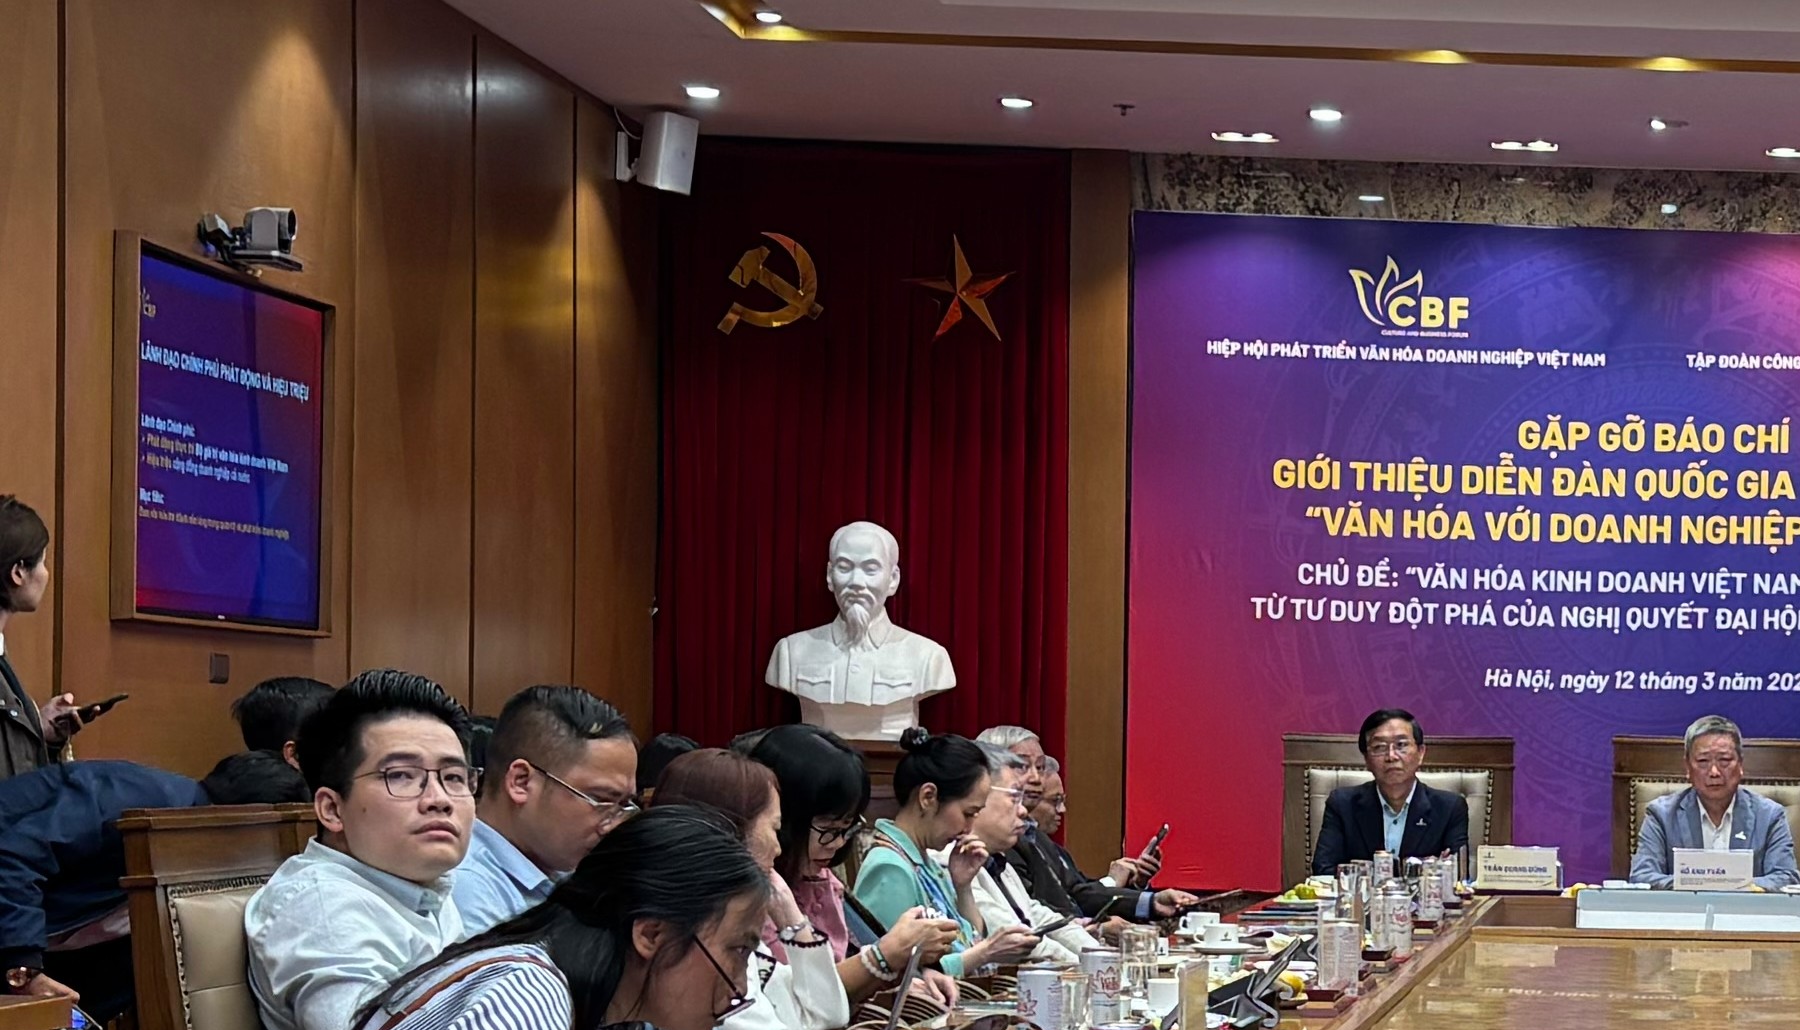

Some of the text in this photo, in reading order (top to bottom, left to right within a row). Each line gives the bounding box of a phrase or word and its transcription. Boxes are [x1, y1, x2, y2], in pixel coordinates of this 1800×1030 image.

[1387, 296, 1470, 329] CBF
[1206, 337, 1606, 370] HIỆP HỘI PHÁT TRIỂN VĂN HÓA DOANH NGHIỆP VIỆT NAM
[1685, 351, 1717, 372] TẬP
[1718, 352, 1761, 369] ĐOÀN
[1516, 413, 1791, 458] GẶP GỠ BÁO CHÍ
[1272, 452, 1341, 490] GIỚI
[1349, 456, 1453, 501] THIỆU
[1461, 452, 1543, 498] DIỄN
[1552, 460, 1627, 498] ĐÀN
[1634, 459, 1729, 502] QUỐC
[1736, 469, 1797, 500] GIA
[1402, 502, 1476, 541] HÓA
[1484, 504, 1541, 542] VỚI
[1549, 512, 1672, 544] DOANH
[1297, 557, 1350, 586] CHỦ
[1356, 557, 1399, 588] ĐỀ:
[1473, 563, 1526, 591] HÓA
[1531, 569, 1592, 593] KINH
[1597, 570, 1685, 594] DOANH
[1690, 567, 1748, 600] VIỆT
[1250, 593, 1288, 620] TỪ
[1289, 597, 1328, 621] TƯ
[1330, 599, 1382, 623] DUY
[1388, 597, 1440, 630] ĐỘT
[1444, 598, 1497, 627] PHÁ
[1502, 598, 1555, 628] CỦA
[1560, 605, 1621, 635] NGHỊ
[1625, 601, 1709, 631] QUYẾT
[1715, 607, 1757, 636] ĐẠI
[1484, 668, 1513, 688] Hà
[1515, 668, 1555, 693] Nội,
[1559, 670, 1610, 694] ngày
[1614, 670, 1635, 690] 12
[1639, 670, 1698, 695] tháng
[1701, 671, 1716, 691] 3
[1718, 672, 1763, 691] năm
